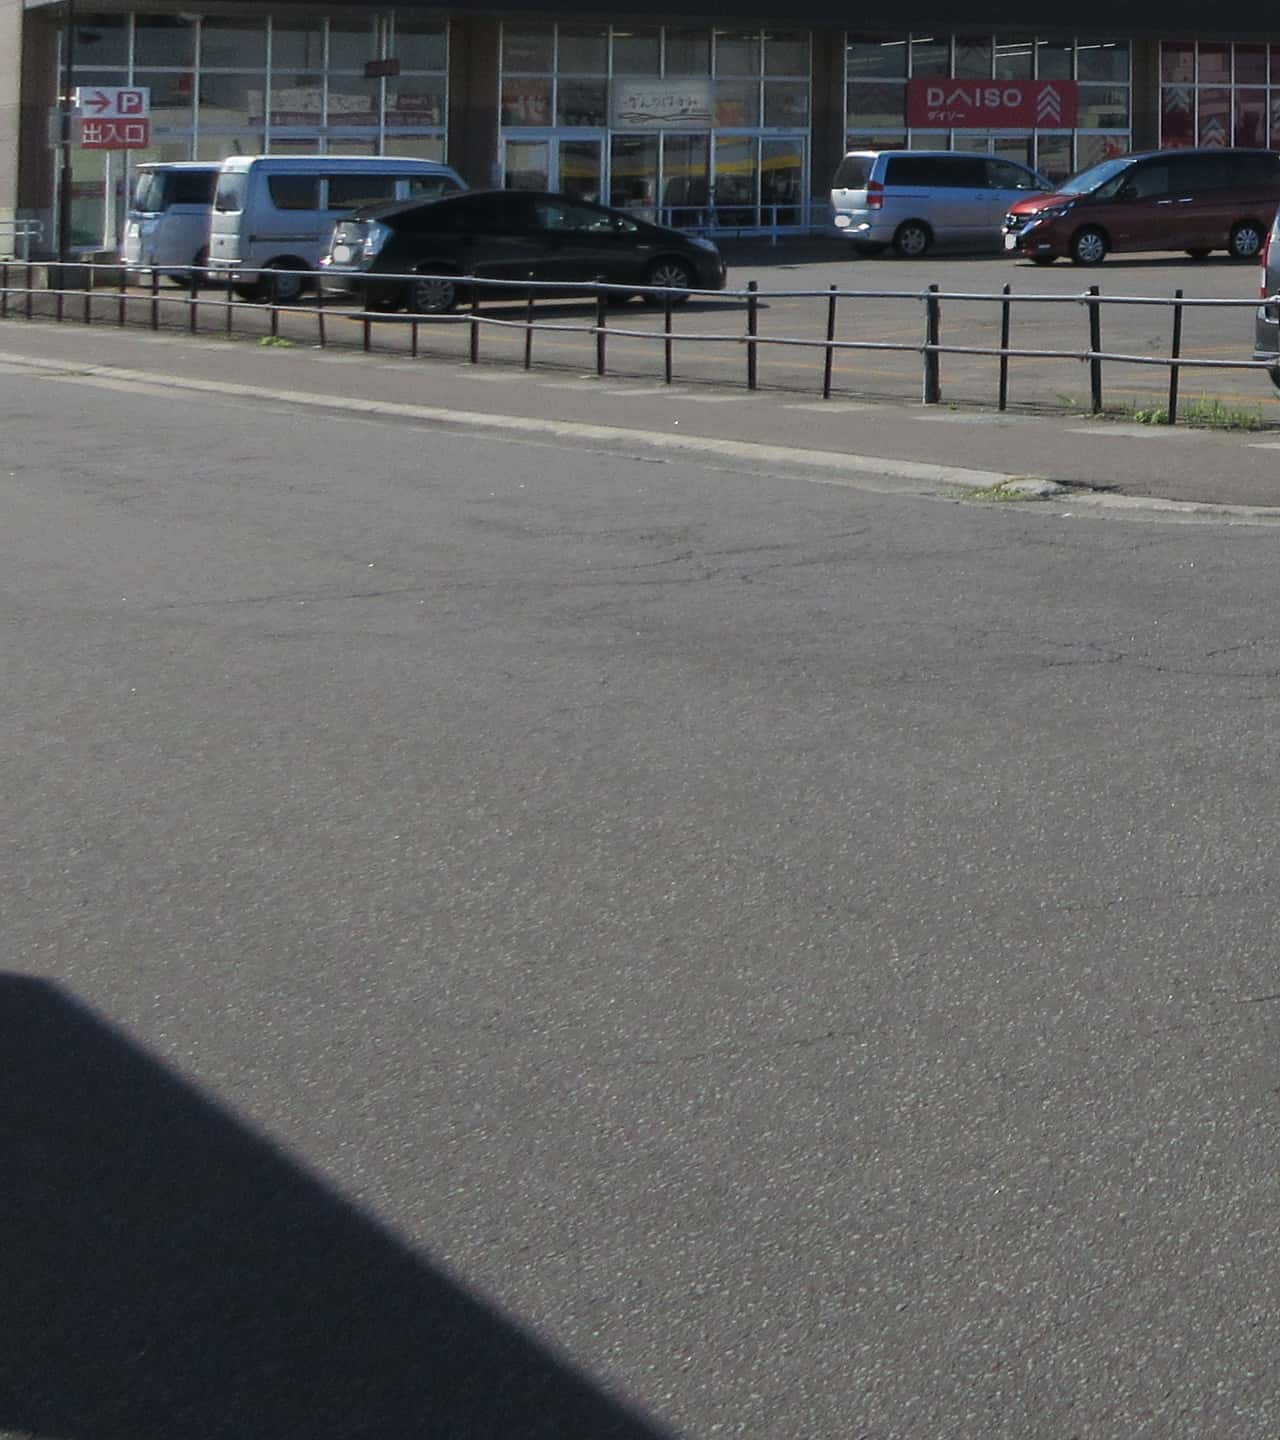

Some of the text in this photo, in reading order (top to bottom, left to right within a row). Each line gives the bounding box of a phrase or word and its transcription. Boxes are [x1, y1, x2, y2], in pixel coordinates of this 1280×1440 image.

[122, 93, 139, 112] P
[927, 88, 1023, 107] DAISO
[83, 123, 144, 143] 出入口
